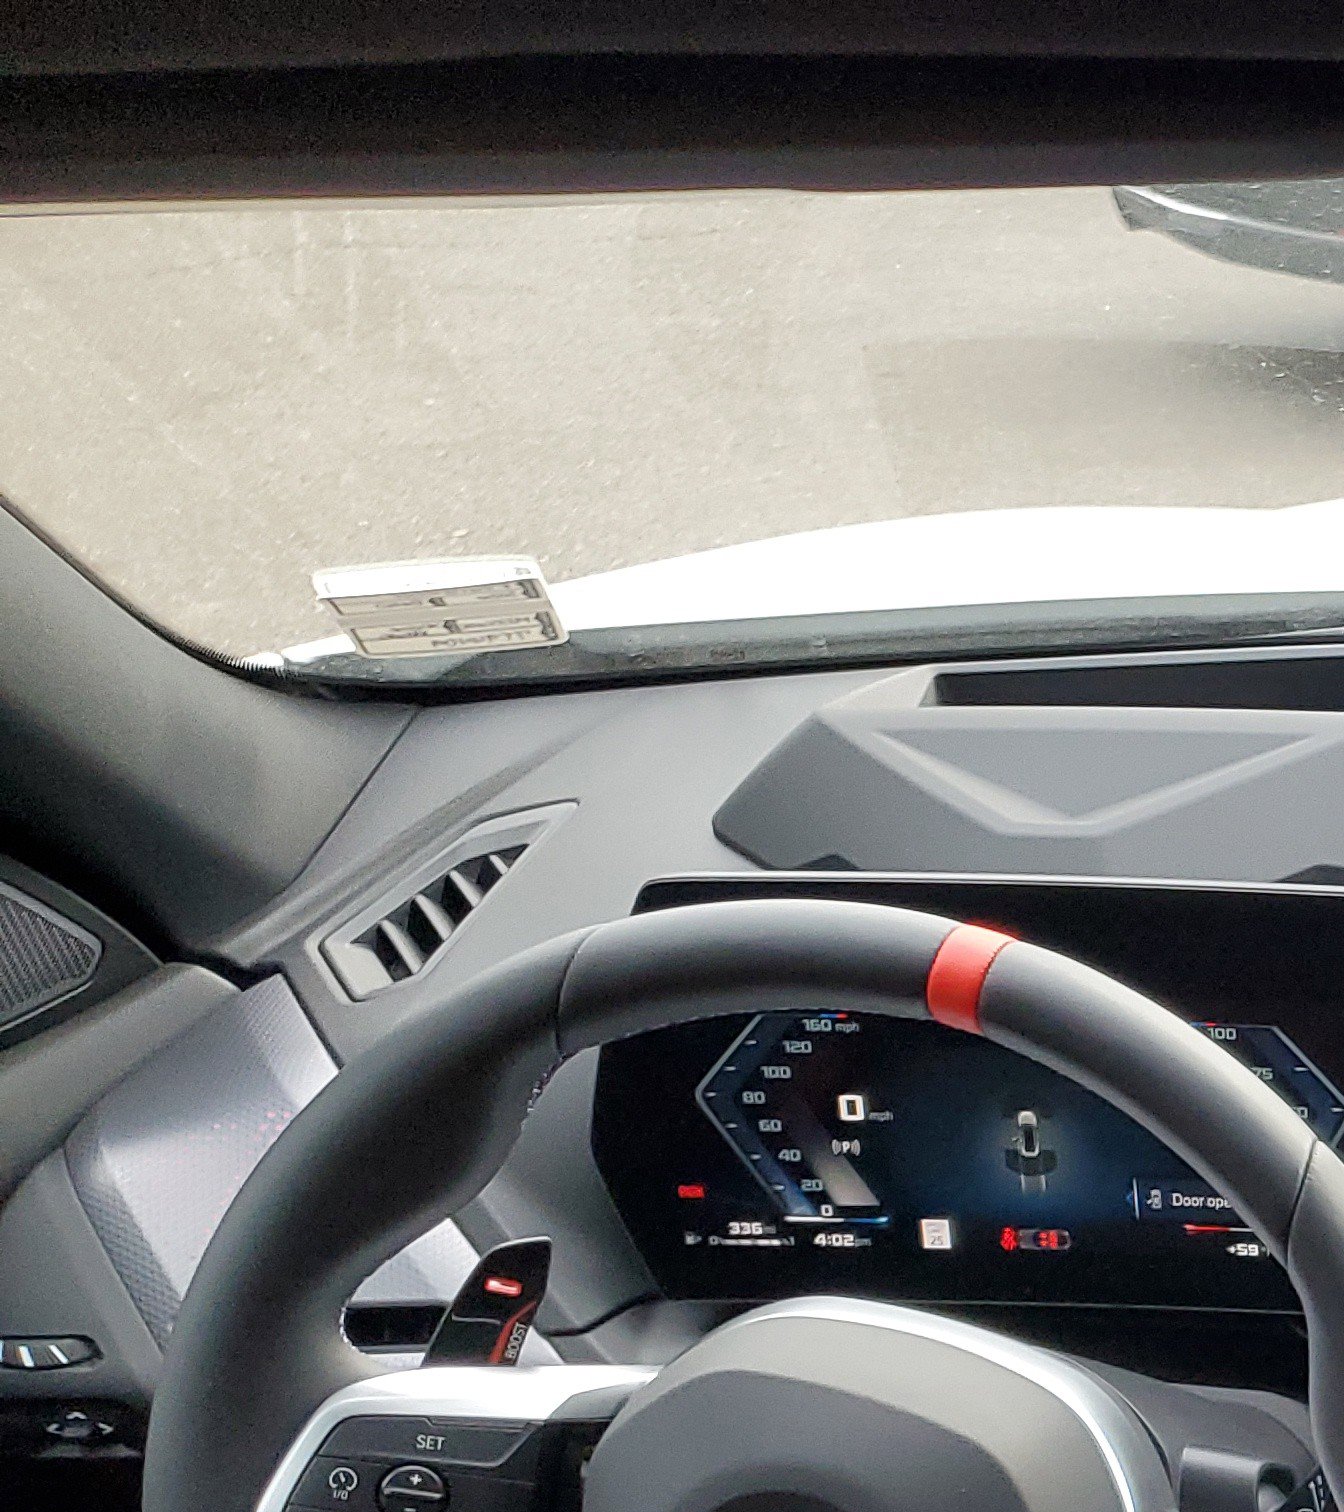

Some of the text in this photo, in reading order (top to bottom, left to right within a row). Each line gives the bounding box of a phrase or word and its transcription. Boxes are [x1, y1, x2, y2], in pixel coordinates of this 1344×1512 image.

[802, 1019, 860, 1034] 160 mph
[1207, 1027, 1237, 1040] 100
[782, 1040, 813, 1054] 120
[760, 1066, 792, 1078] 100
[1250, 1066, 1274, 1080] 75
[742, 1090, 766, 1104] 80
[838, 1094, 865, 1122] 0
[758, 1119, 782, 1132] 60
[778, 1150, 801, 1162] 40
[801, 1178, 823, 1191] 20
[1172, 1192, 1232, 1210] Door ope
[820, 1204, 833, 1216] 0
[728, 1222, 763, 1234] 336
[813, 1233, 855, 1247] 4:02
[930, 1236, 944, 1246] 25
[506, 1322, 530, 1360] BOOST
[416, 1434, 446, 1450] SET
